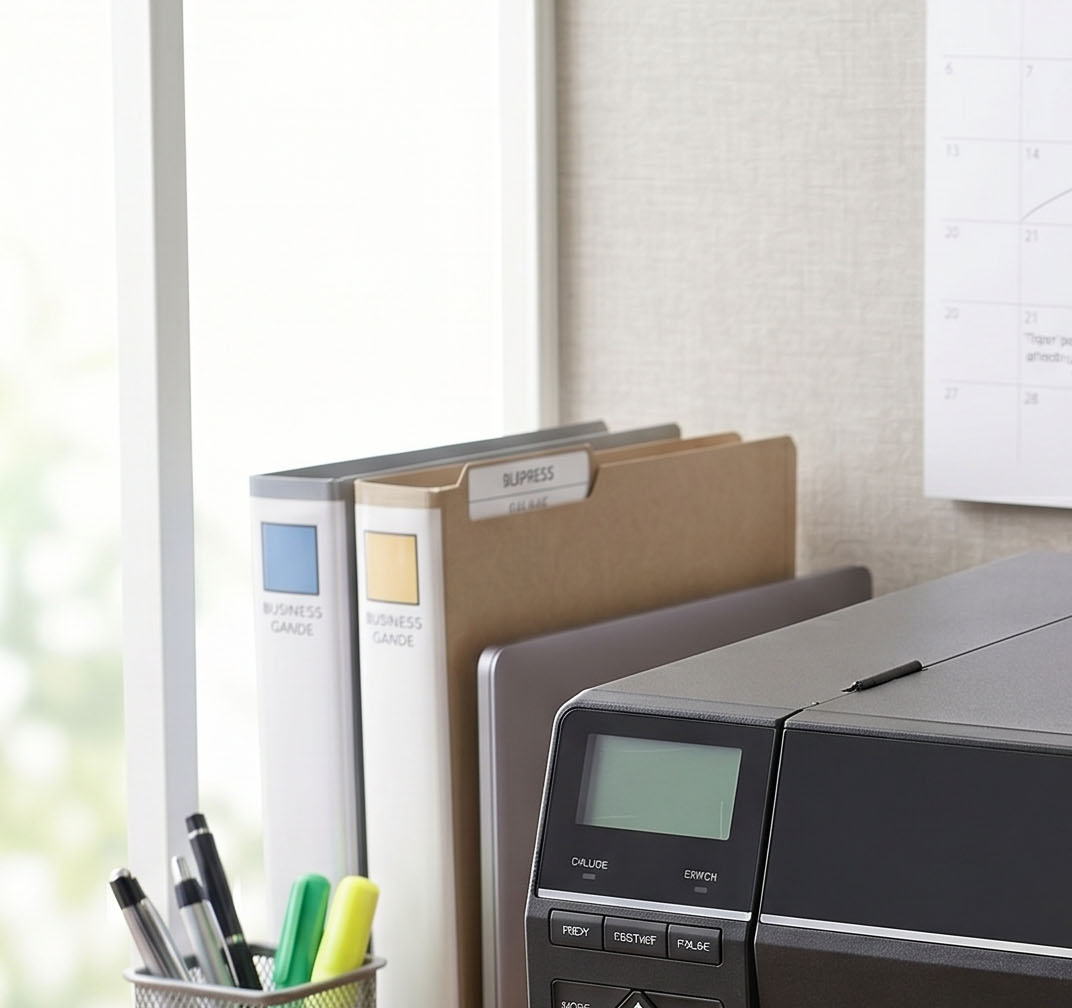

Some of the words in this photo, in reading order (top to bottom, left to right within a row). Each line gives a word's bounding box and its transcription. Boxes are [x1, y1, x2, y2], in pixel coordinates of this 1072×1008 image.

[1026, 64, 1034, 78] 7
[1025, 147, 1040, 160] 14
[1024, 229, 1039, 242] 21
[1024, 310, 1038, 324] 21
[263, 602, 323, 620] BUSINESS
[366, 611, 423, 630] BUSINESS
[271, 620, 314, 637] GANDE
[372, 630, 415, 648] GANDE
